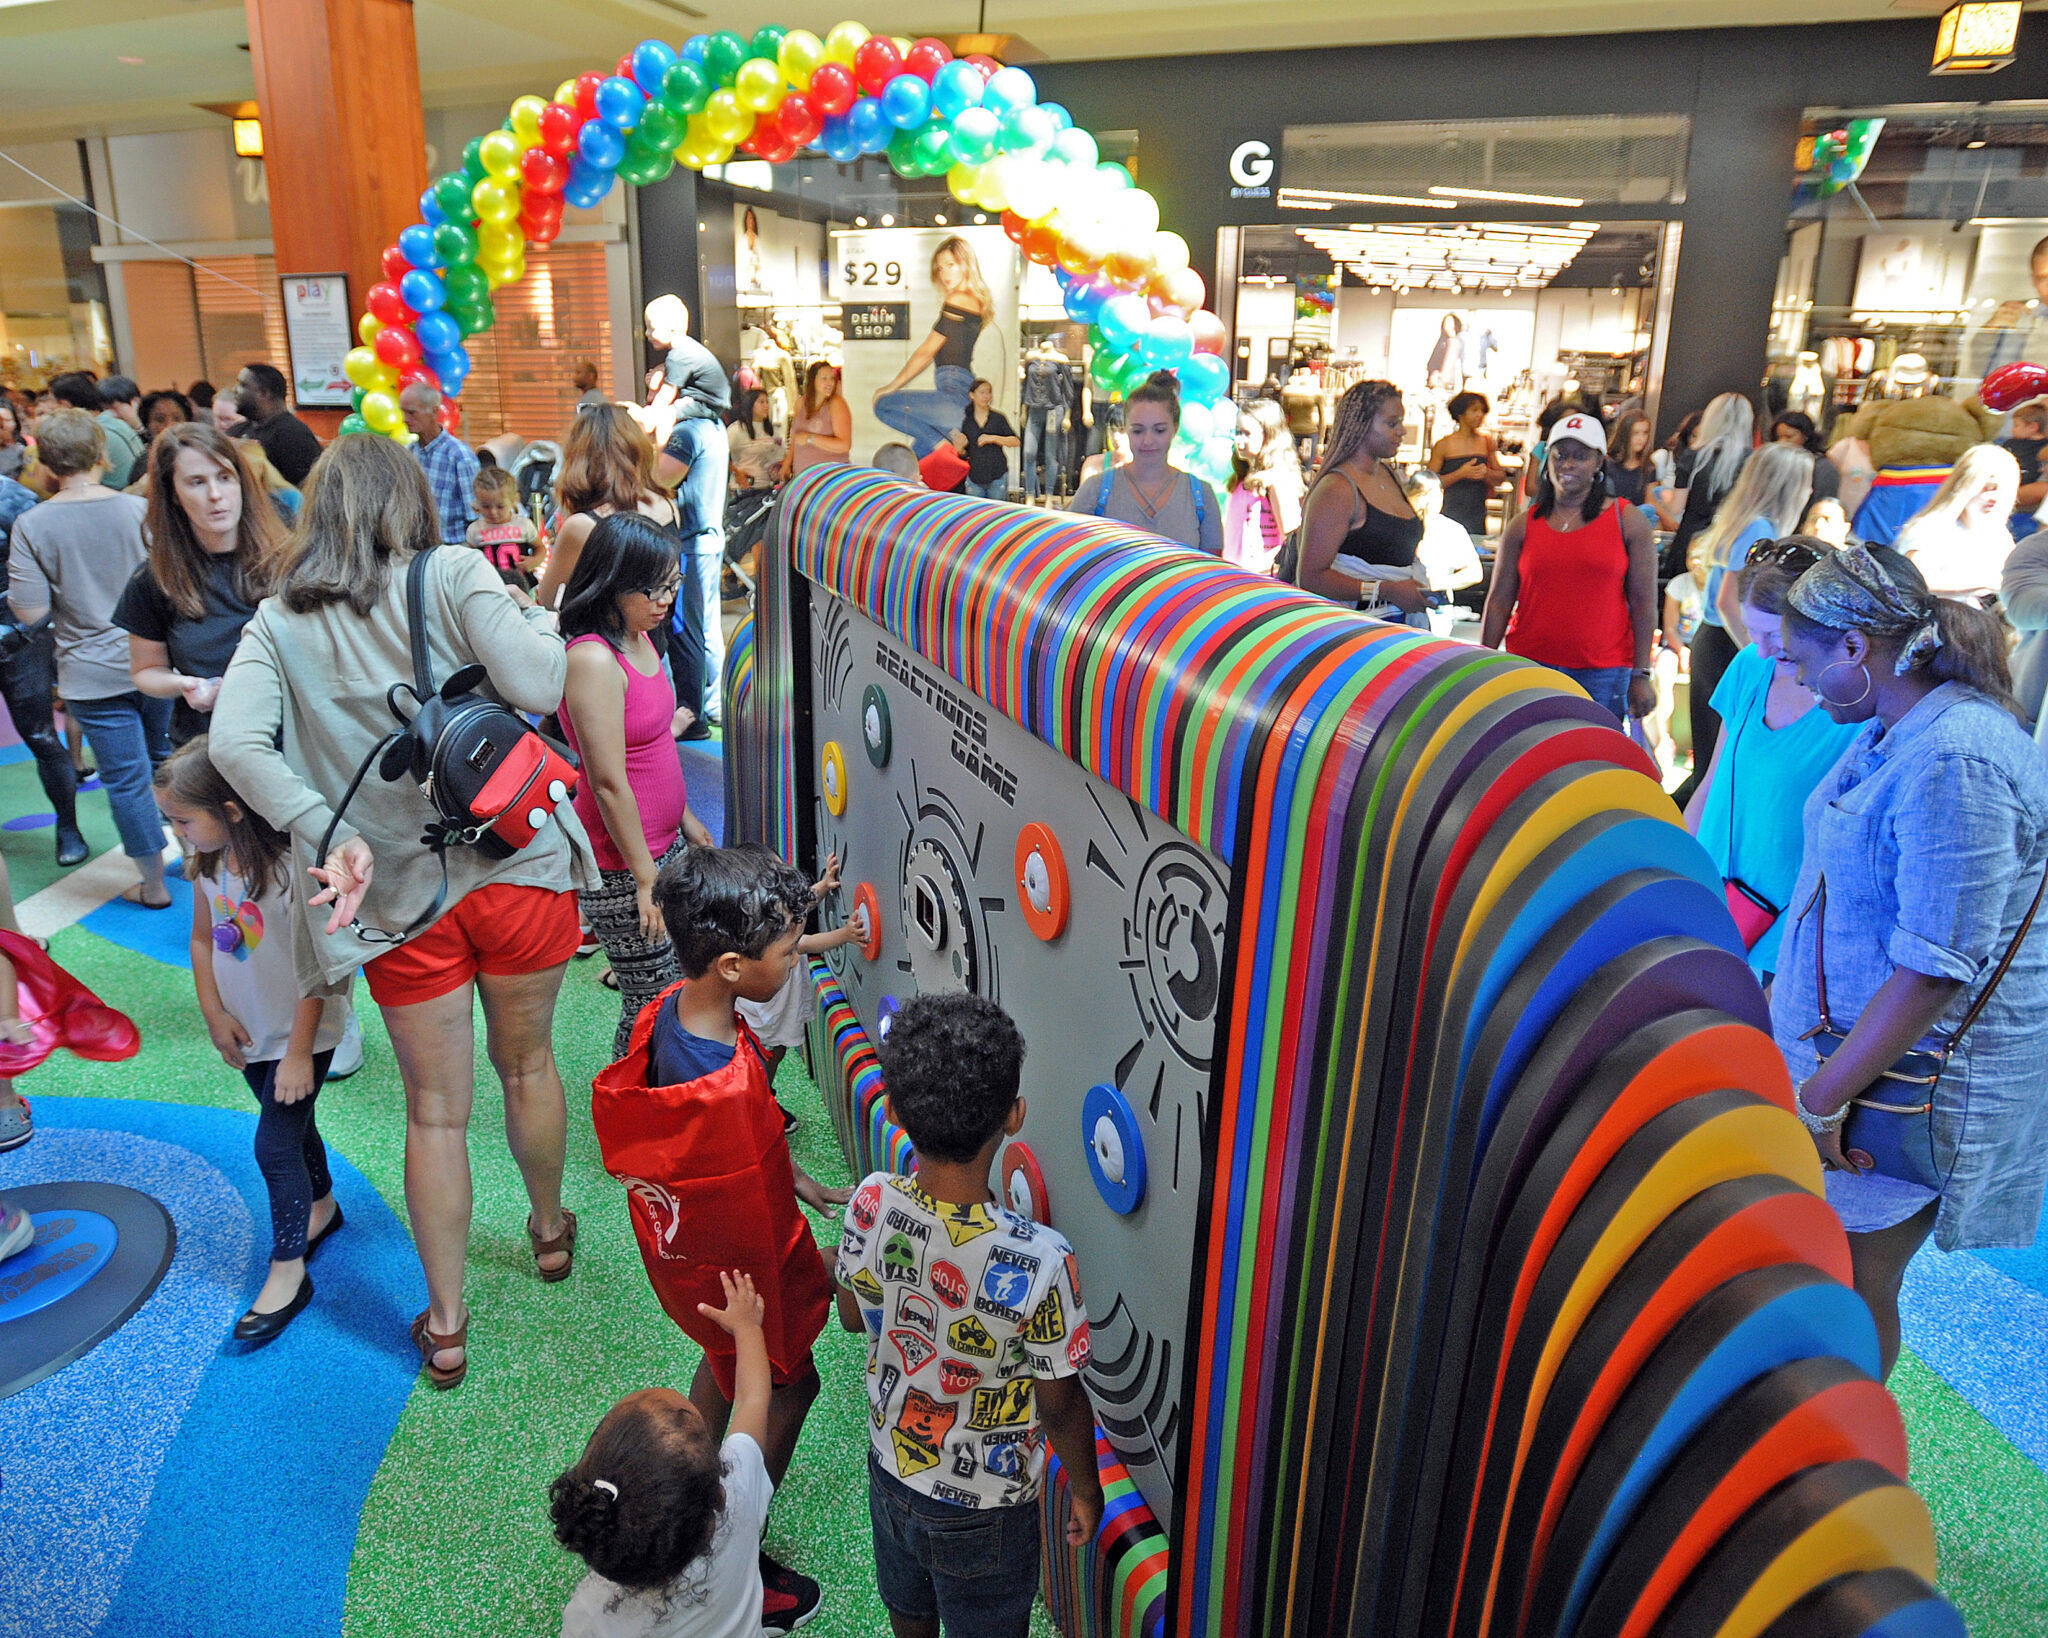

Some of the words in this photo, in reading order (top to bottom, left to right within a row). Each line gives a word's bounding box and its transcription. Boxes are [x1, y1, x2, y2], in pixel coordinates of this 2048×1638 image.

[1230, 140, 1274, 187] G
[844, 261, 902, 286] $29
[851, 312, 896, 325] DENIM
[855, 325, 893, 337] SHOP
[480, 526, 522, 542] XOXO
[876, 640, 988, 749] REACTIONS
[951, 729, 1018, 809] GAME
[886, 1210, 927, 1241] WEIRD
[990, 1247, 1039, 1273] NEVER
[932, 1268, 967, 1299] STOP
[976, 1297, 1024, 1323] BORED
[949, 1335, 958, 1348] IN
[957, 1340, 993, 1357] CONTROL
[940, 1366, 980, 1388] STOP
[984, 1431, 1028, 1446] BORED
[934, 1483, 980, 1508] NEVER
